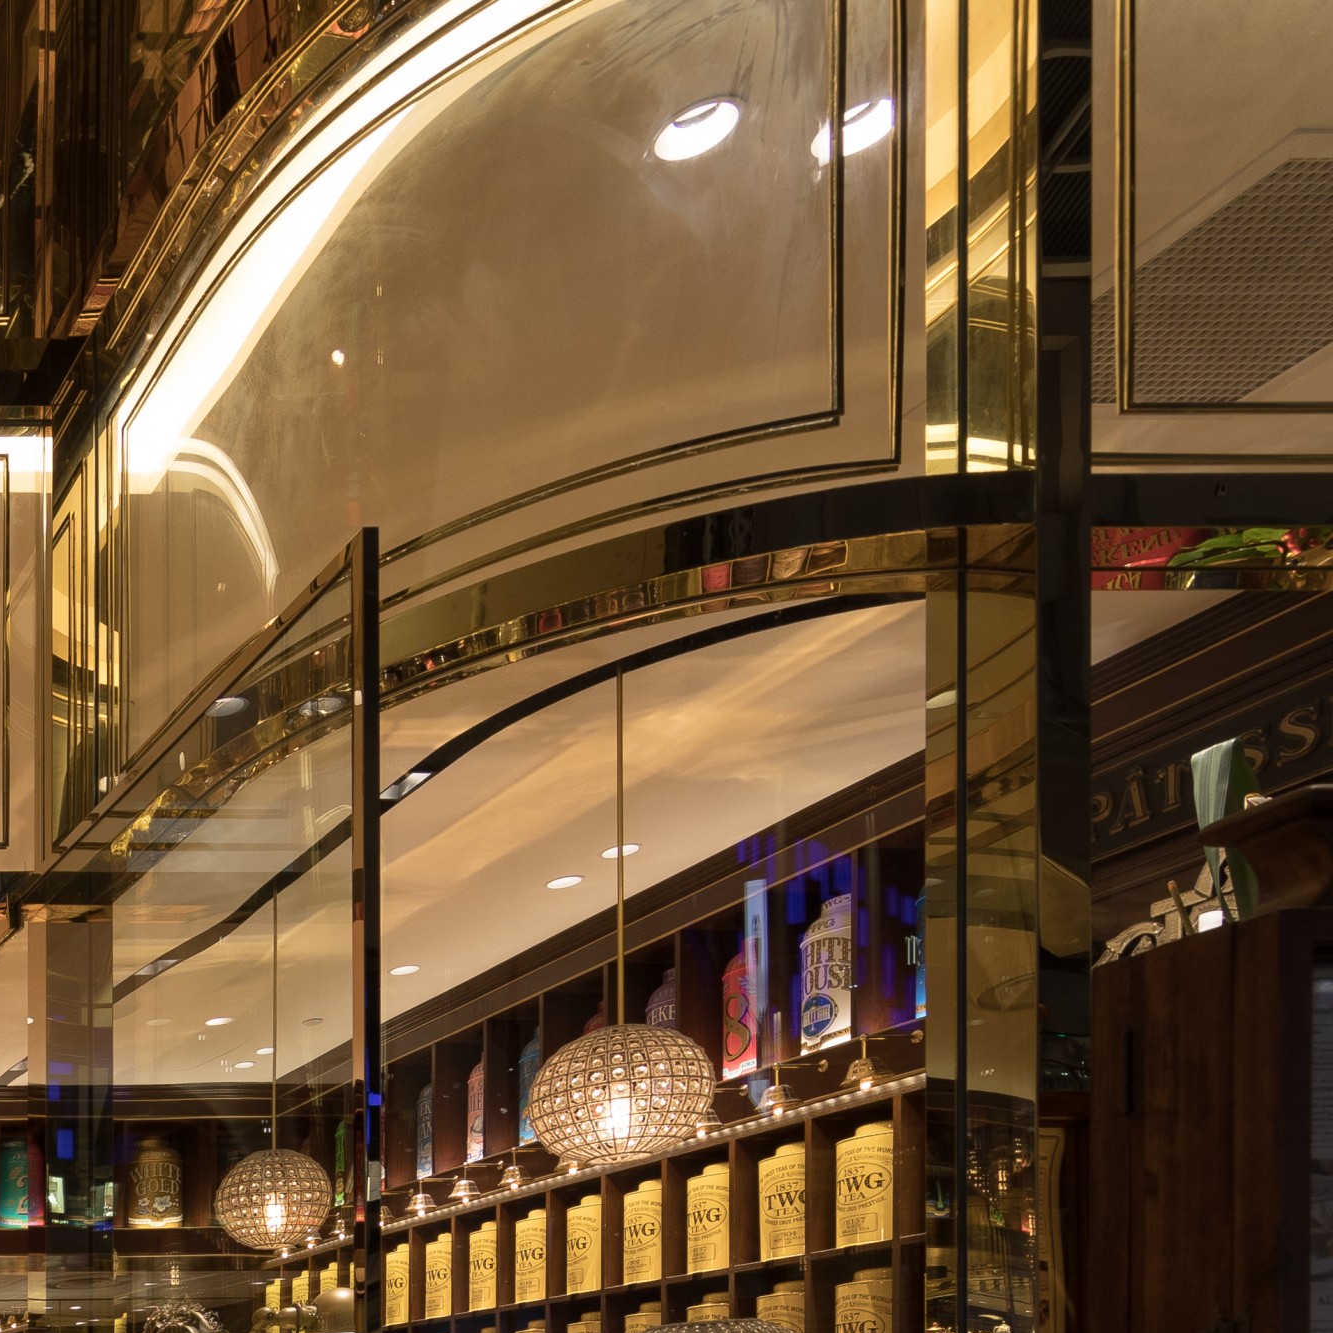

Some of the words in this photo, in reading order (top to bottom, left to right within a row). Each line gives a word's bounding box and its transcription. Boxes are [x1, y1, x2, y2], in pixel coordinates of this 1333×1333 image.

[129, 1162, 182, 1183] WHITE
[844, 1165, 865, 1177] 1837
[134, 1179, 180, 1197] GOLD
[775, 1181, 798, 1193] 1837
[843, 1191, 866, 1203] TEA
[774, 1206, 800, 1217] TEA
[840, 1312, 860, 1322] 1837
